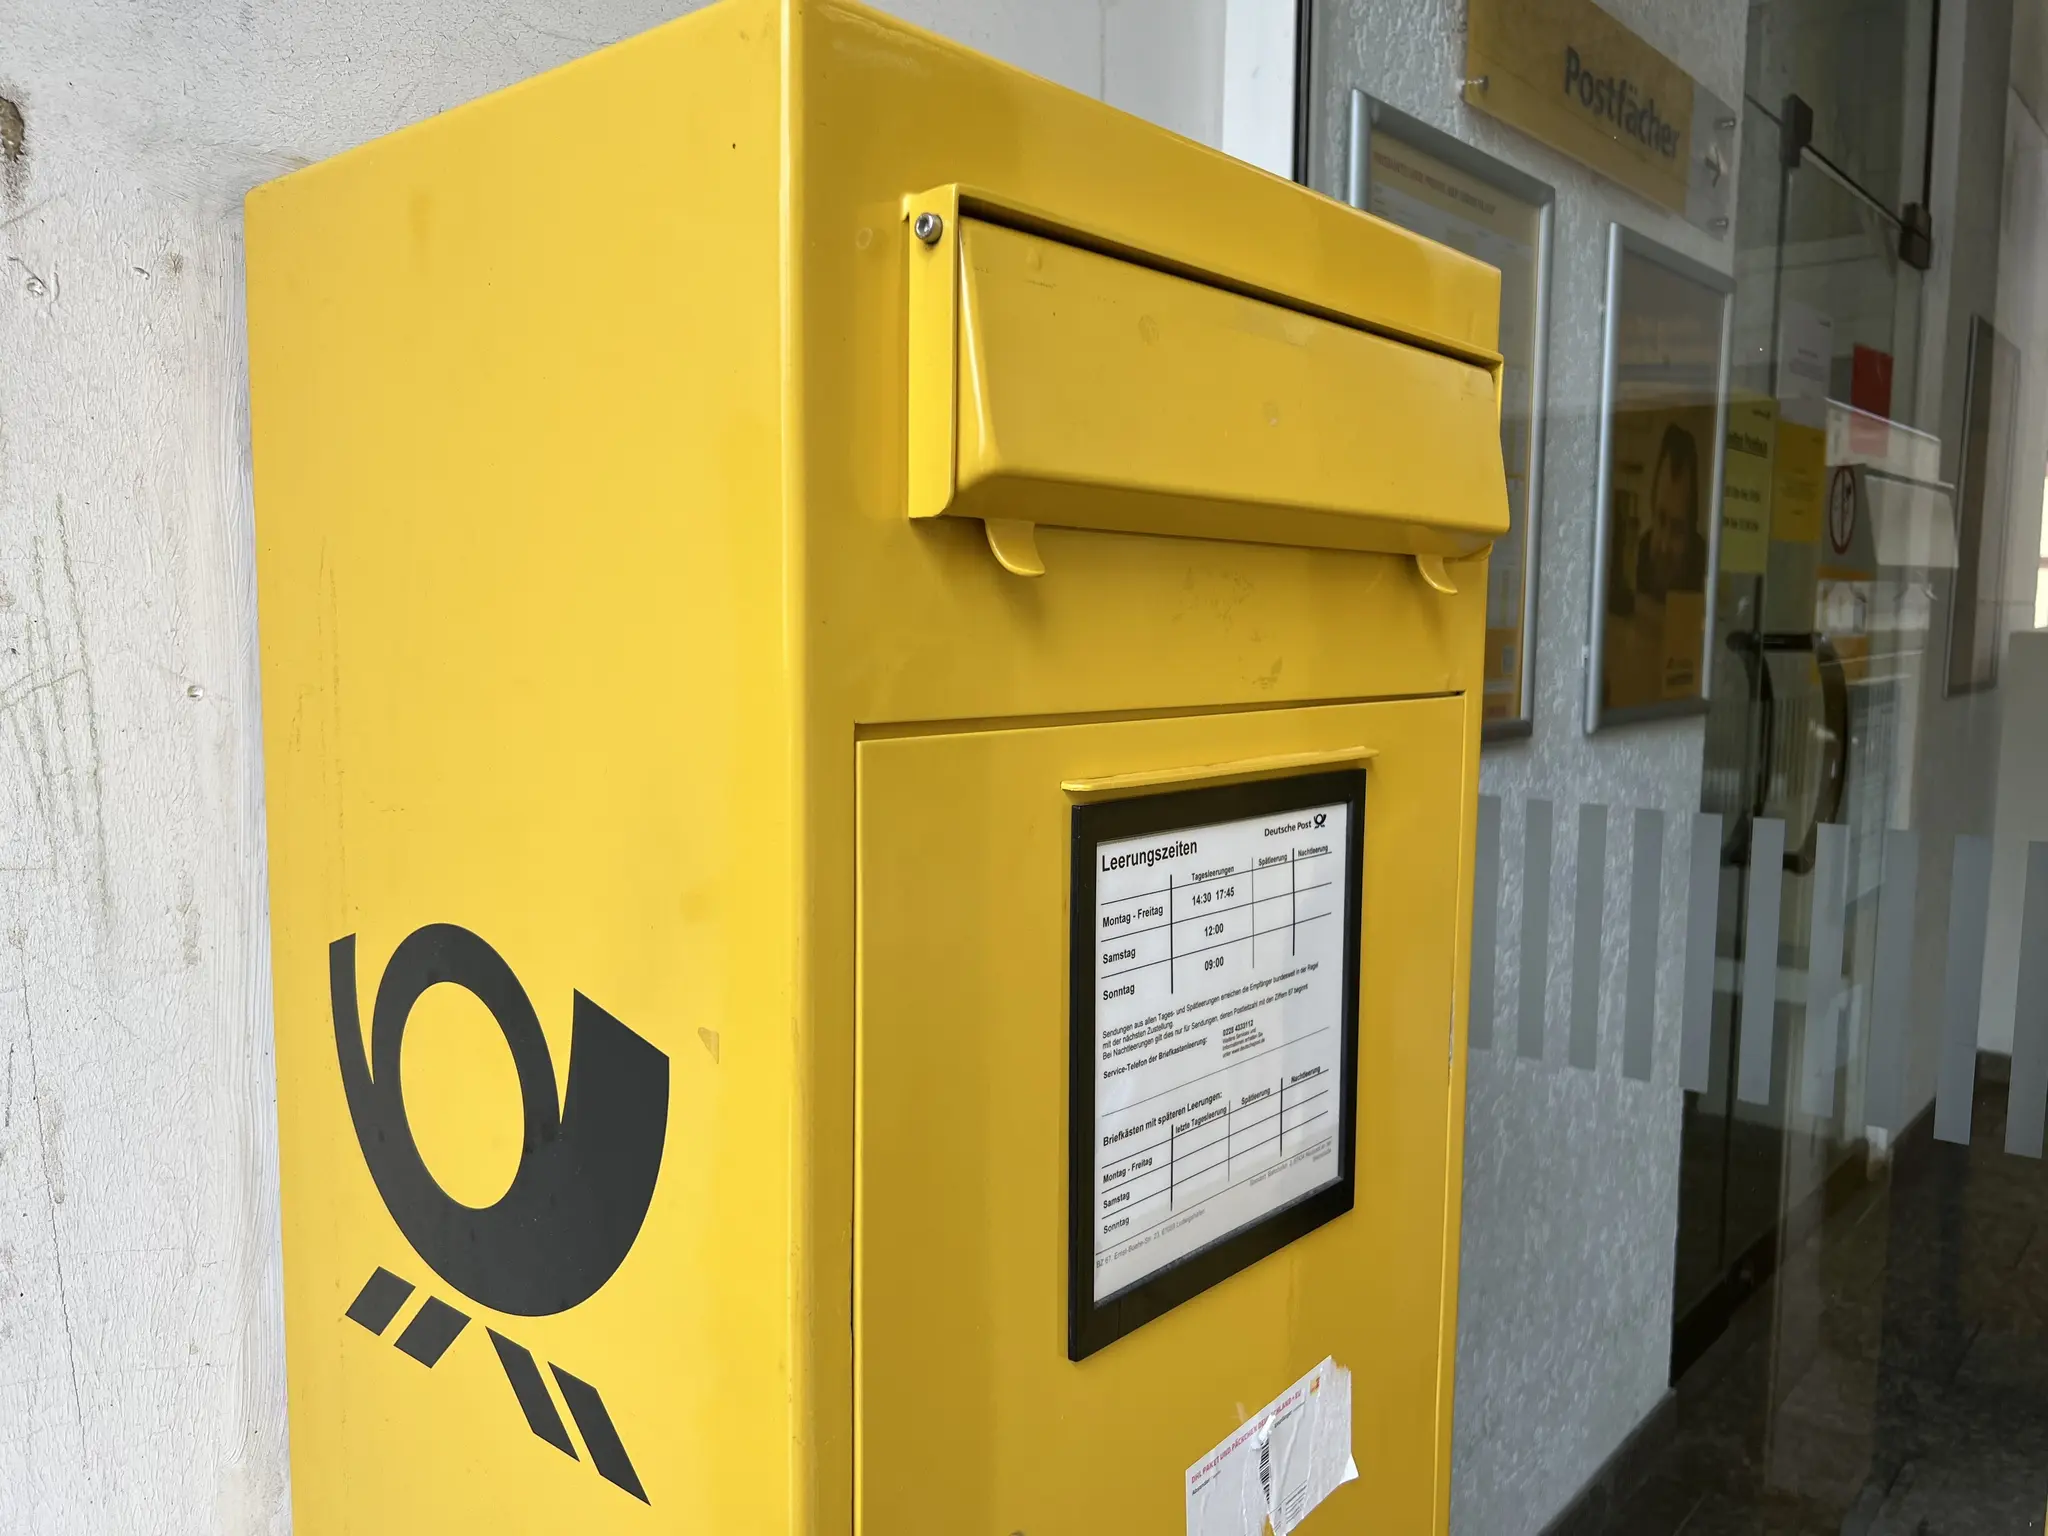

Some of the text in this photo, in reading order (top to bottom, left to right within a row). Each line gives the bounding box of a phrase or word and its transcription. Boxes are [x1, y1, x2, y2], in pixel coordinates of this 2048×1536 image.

[1564, 45, 1680, 159] Postfächer
[1264, 820, 1312, 837] Deutsche Post
[1102, 841, 1197, 872] Leerungszeiten
[1298, 845, 1328, 857] Nachtleerung
[1258, 854, 1288, 867] Spätleerung
[1191, 866, 1234, 881] Tagesleerungen
[1192, 887, 1235, 906] 14:30 17:45
[1102, 914, 1131, 928] Montag
[1137, 906, 1163, 920] Freitag
[1204, 923, 1224, 937] 12:00
[1102, 948, 1136, 965] Samstag
[1204, 956, 1224, 971] 09:00
[1103, 984, 1135, 1001] Sonntag
[1102, 1023, 1133, 1039] Sendungen
[1134, 1021, 1144, 1029] aus
[1144, 1015, 1157, 1026] allen
[1158, 1011, 1175, 1023] Tages-
[1176, 1006, 1186, 1015] und
[1186, 996, 1220, 1013] Spätleerungen
[1221, 987, 1241, 1001] erreichen
[1249, 978, 1273, 992] Empfänger
[1102, 1051, 1112, 1061] Bei
[1113, 1038, 1154, 1057] Nachtleerungen
[1155, 1035, 1163, 1045] gilt
[1163, 1031, 1174, 1040] dies
[1174, 1027, 1183, 1036] nur
[1183, 1024, 1191, 1033] für
[1219, 1009, 1233, 1021] deren
[1102, 1040, 1111, 1050] mit
[1112, 1037, 1122, 1047] der
[1122, 1029, 1146, 1043] nächsten
[1103, 1058, 1148, 1079] Service-Telefon
[1148, 1054, 1158, 1064] der
[1158, 1036, 1208, 1061] Briefkastenleerung:
[1290, 1066, 1321, 1084] Nachtleerung
[1241, 1087, 1271, 1105] Spätleerung
[1103, 1091, 1223, 1147] Briefkästen mit späteren Leerungen:
[1175, 1106, 1227, 1134] letzte Tagesleerung
[1103, 1168, 1127, 1184] Montag
[1131, 1157, 1153, 1172] Freitag
[1103, 1191, 1131, 1209] Samstag
[1103, 1217, 1130, 1235] Sonntag
[1191, 1472, 1202, 1484] DHL
[1202, 1455, 1220, 1472] PAKET
